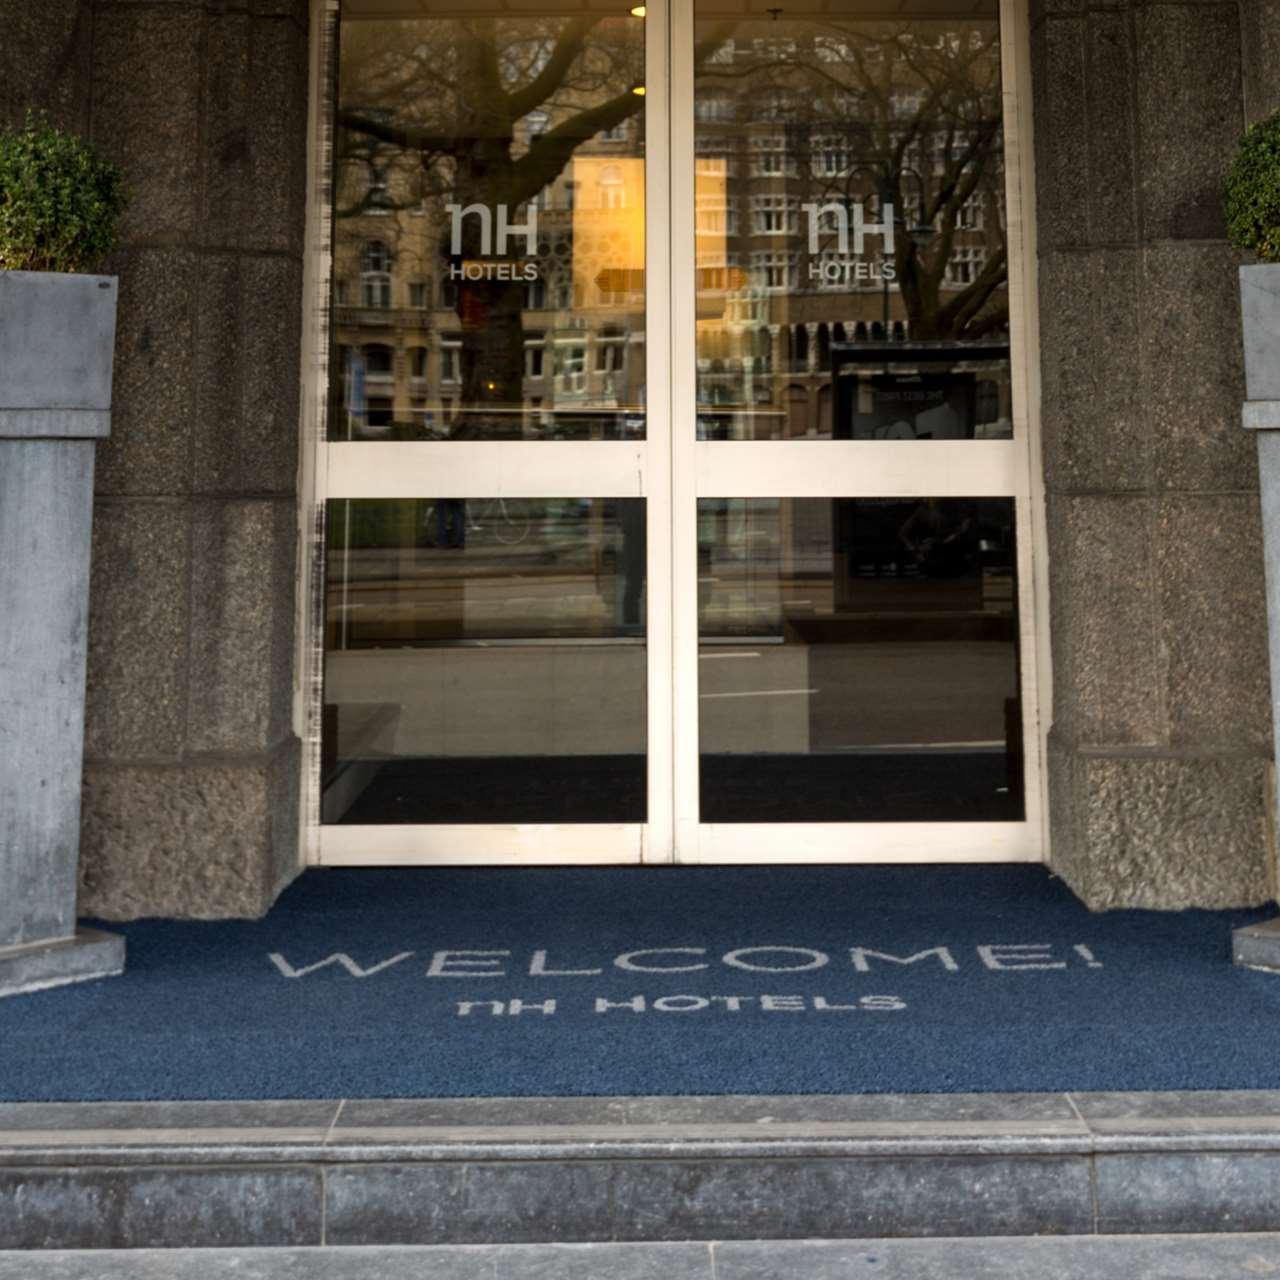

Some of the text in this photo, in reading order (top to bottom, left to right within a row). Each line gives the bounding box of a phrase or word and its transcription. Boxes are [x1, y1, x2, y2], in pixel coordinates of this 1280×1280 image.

[449, 262, 539, 282] HOTELS
[807, 261, 897, 282] HOTELS
[267, 944, 1104, 979] WELCOME!
[594, 994, 908, 1014] HOTELS
